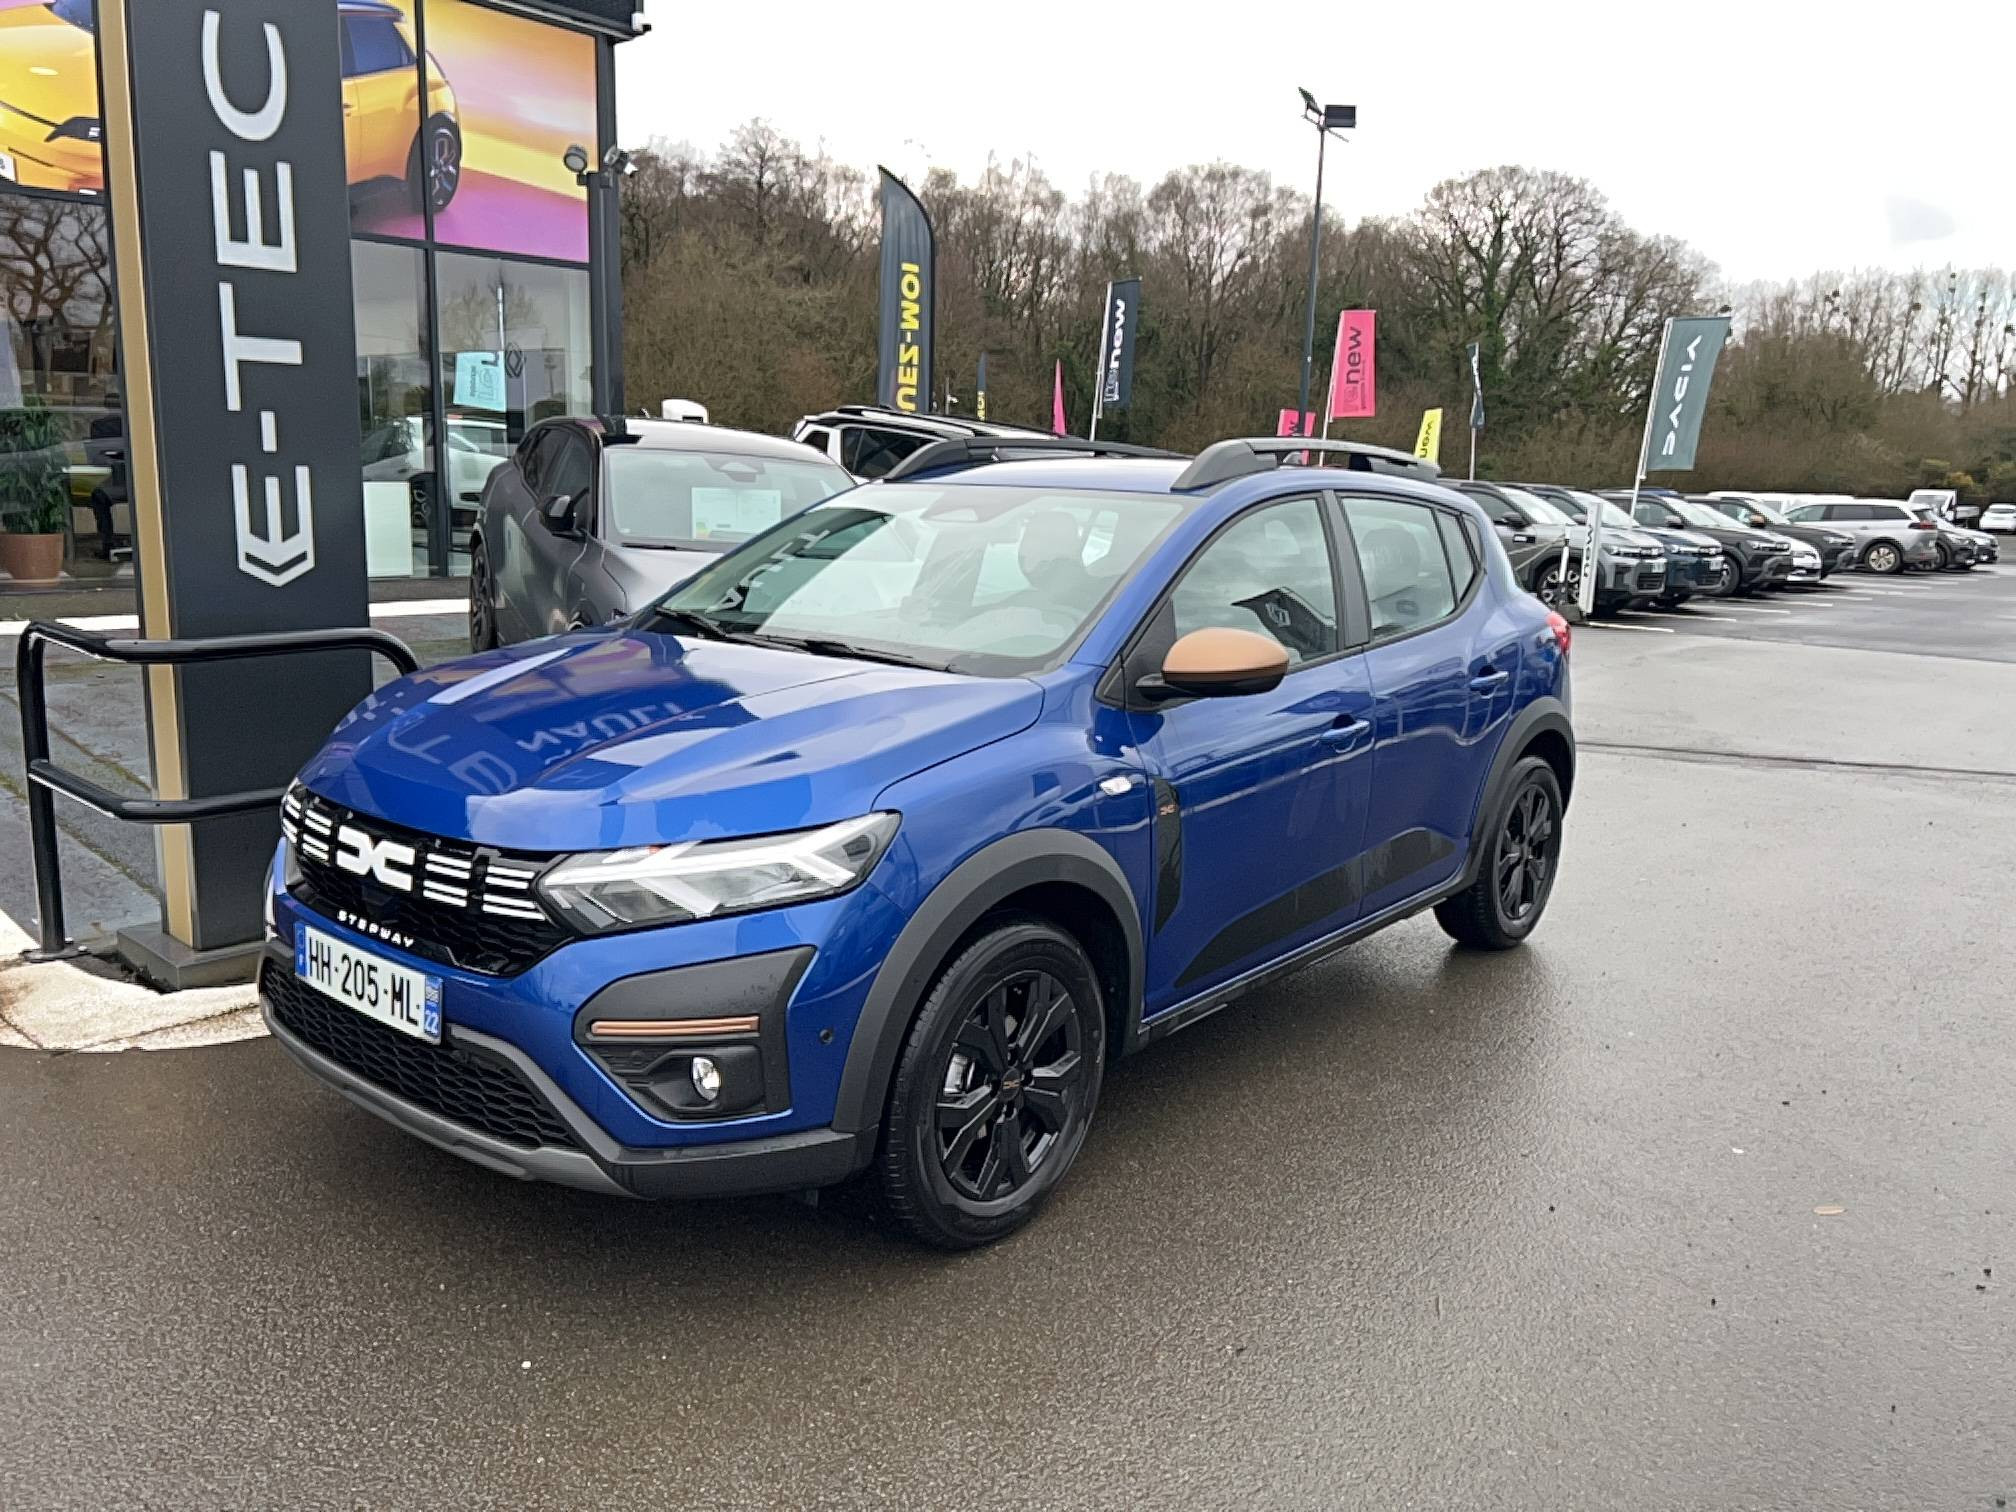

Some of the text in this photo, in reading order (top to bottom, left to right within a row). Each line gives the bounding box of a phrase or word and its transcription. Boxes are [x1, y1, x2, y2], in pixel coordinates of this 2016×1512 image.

[202, 8, 315, 588] E-TEC
[1661, 335, 1703, 456] DACIA
[337, 909, 414, 948] STEPWAY
[424, 1009, 440, 1035] 22
